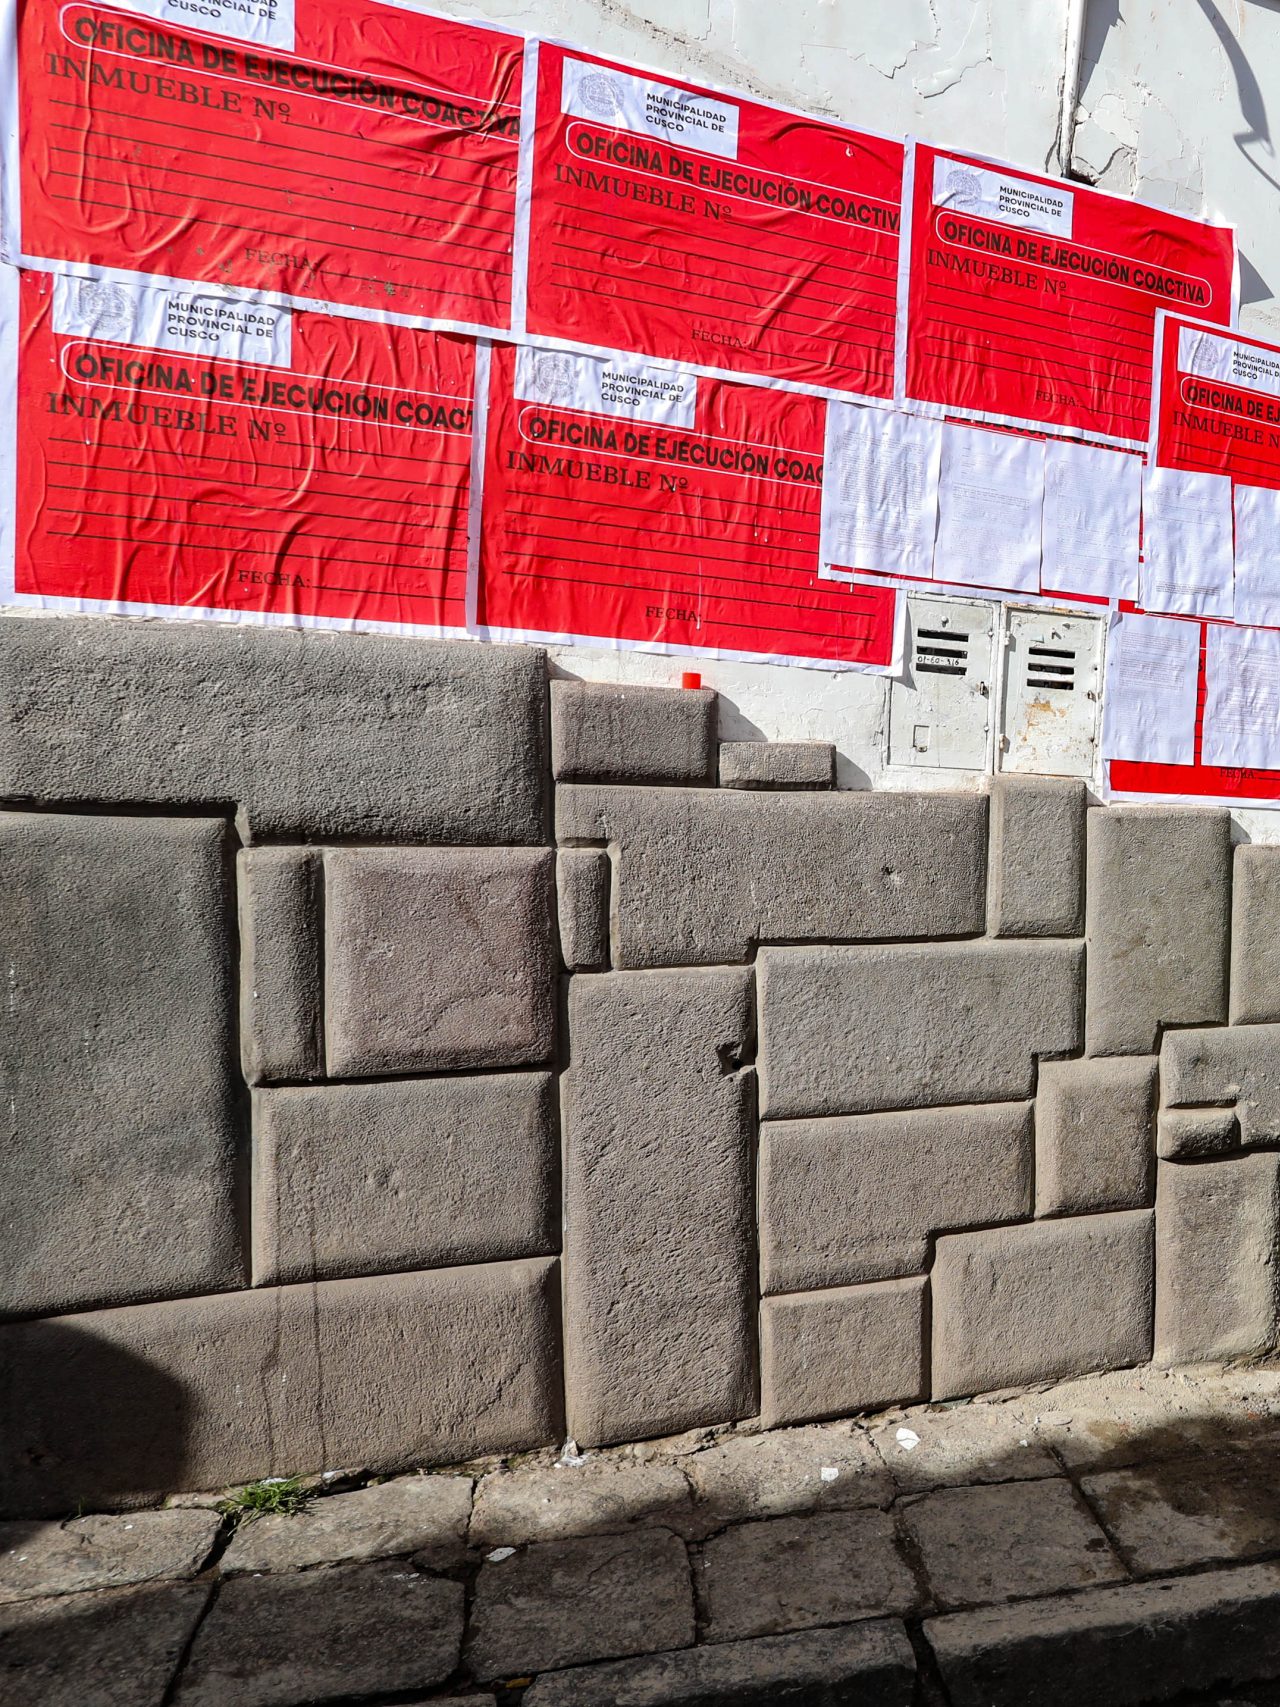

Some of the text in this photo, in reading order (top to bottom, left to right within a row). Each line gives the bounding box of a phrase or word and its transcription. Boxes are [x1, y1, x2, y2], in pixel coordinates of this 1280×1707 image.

[168, 0, 222, 18] CUSCO
[258, 8, 277, 20] DE
[75, 17, 195, 66] OFICINA
[202, 48, 237, 74] DE
[245, 52, 401, 108] EJECUCIÓN
[47, 53, 242, 113] INMUEBLE
[646, 92, 727, 123] MUNICIPALIDAD
[646, 103, 725, 133] PROVINCIAL DE
[645, 115, 685, 133] CUSCO
[554, 164, 696, 215] INMUEBLE
[576, 132, 900, 231] OFICINA DE EJECUCIÓN COACTIV
[999, 185, 1064, 208] MUNICIPALIDAD
[999, 195, 1062, 217] PROVINCIAL DE
[999, 205, 1030, 218] CUSCO
[927, 248, 1038, 289] INMUEBLE
[944, 221, 1206, 303] OFICINA DE EJECUCIÓN COACTIVA
[168, 300, 275, 327] MUNICIPALIDAD
[168, 313, 273, 338] PROVINCIAL DE
[167, 326, 219, 342] CUSCO
[602, 371, 685, 393] MUNICIPALIDAD
[1232, 368, 1258, 380] CUSCO
[1233, 359, 1273, 377] PROVINCIAL
[75, 353, 193, 393] OFICINA
[201, 372, 235, 398] DE
[242, 376, 388, 420] EJECUCIÓN
[601, 382, 683, 403] PROVINCIAL DE
[601, 393, 640, 407] CUSCO
[47, 392, 238, 437] INMUEBLE
[1187, 385, 1243, 414] OFICINA
[1248, 399, 1263, 418] DE
[1173, 411, 1264, 445] INMUEBLE
[529, 416, 618, 451] OFICINA
[623, 433, 649, 456] DE
[655, 438, 769, 475] EJECUCIÓN
[506, 450, 651, 489] INMUEBLE
